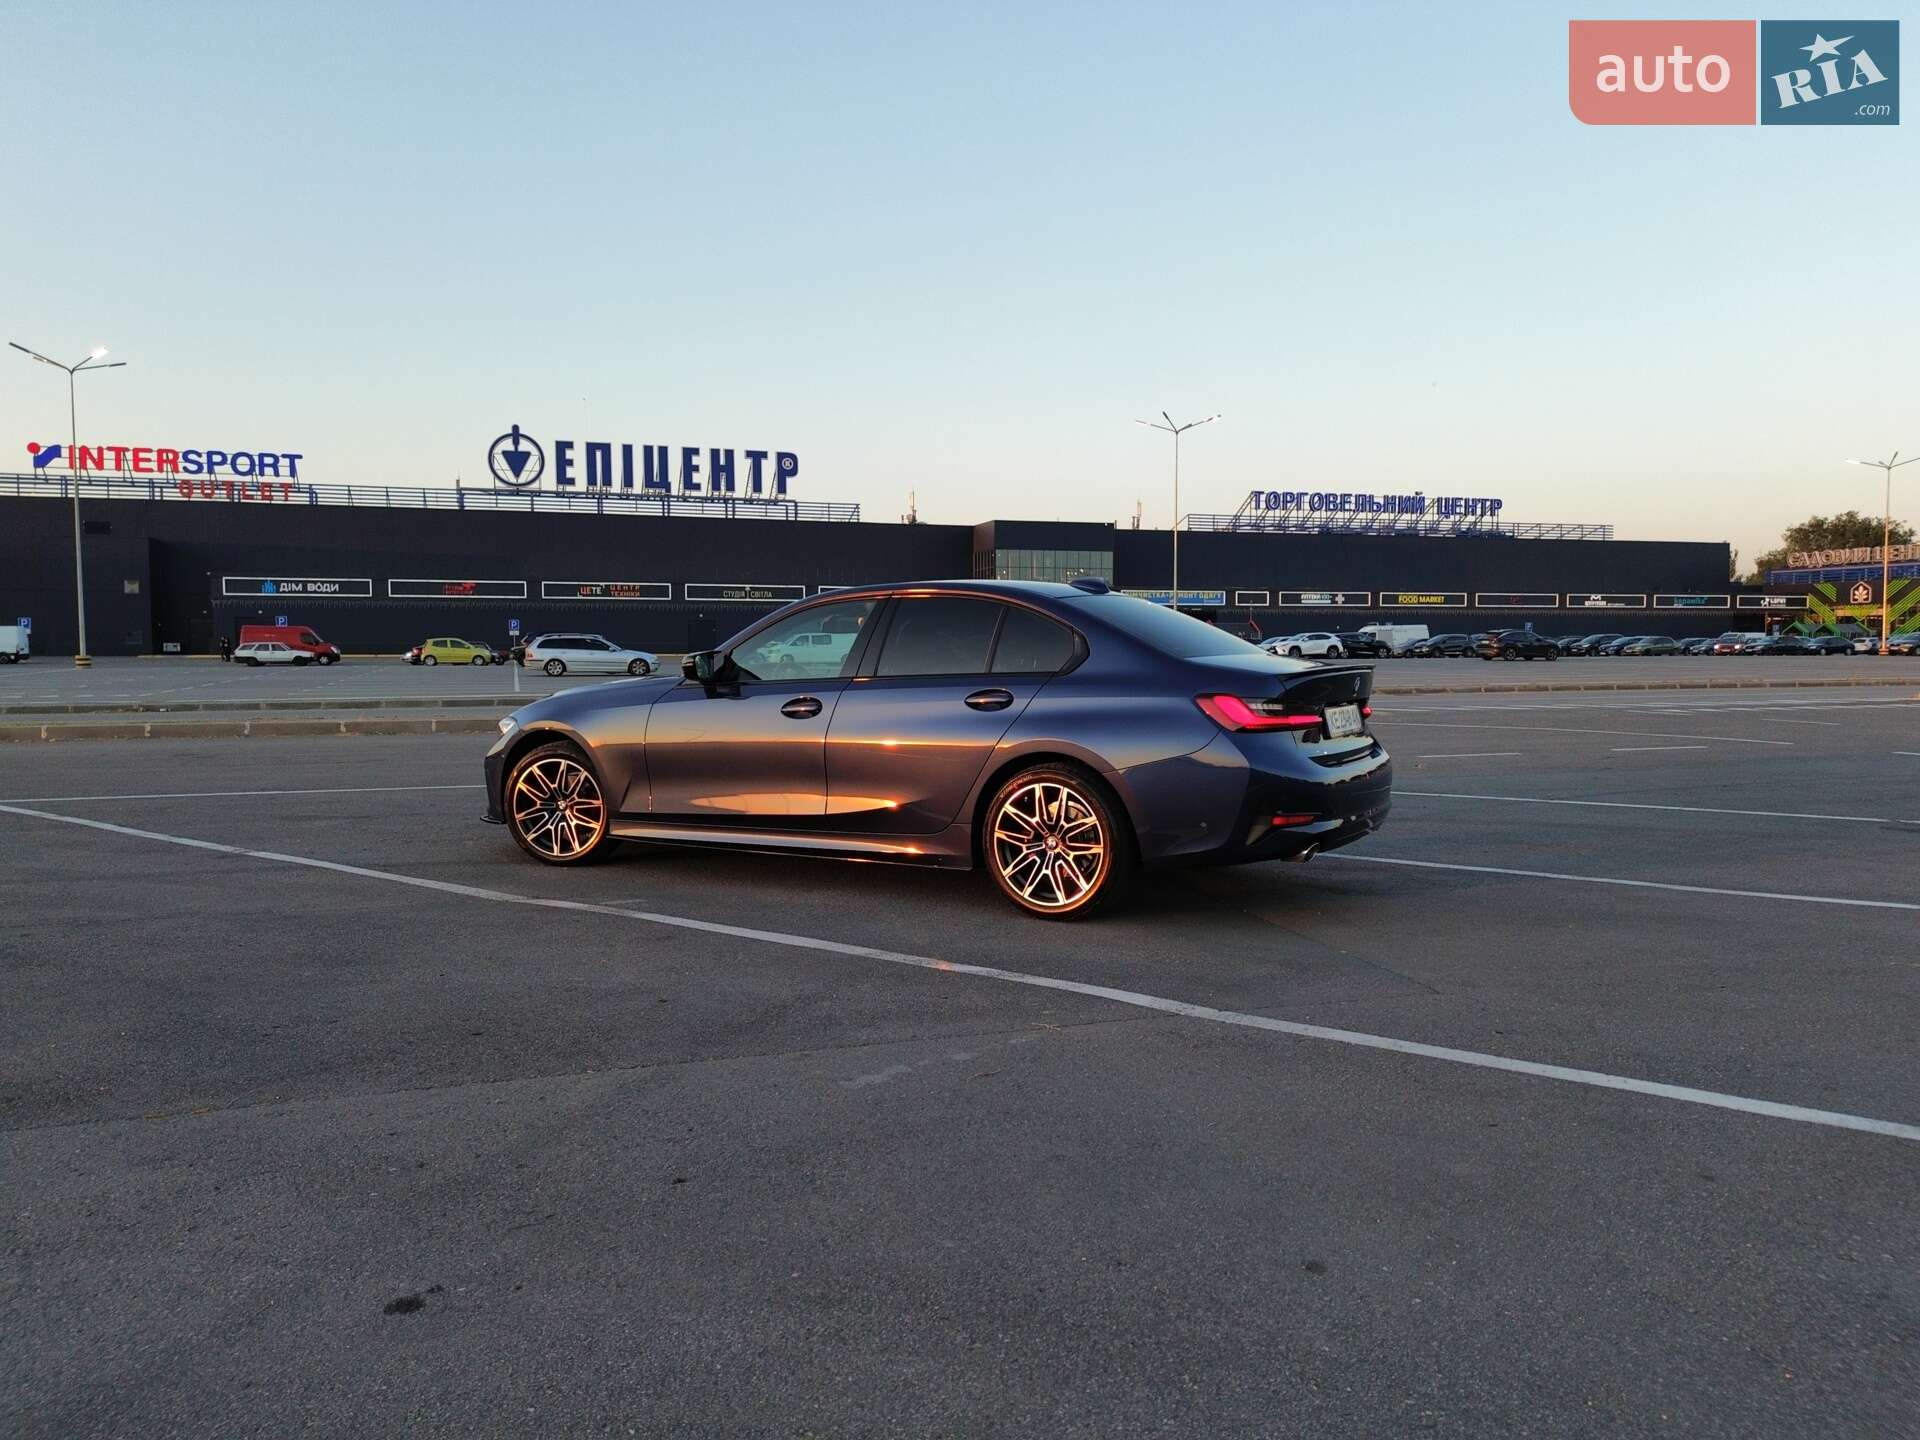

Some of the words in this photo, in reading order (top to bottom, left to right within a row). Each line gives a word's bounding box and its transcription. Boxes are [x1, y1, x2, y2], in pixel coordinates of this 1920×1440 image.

[68, 444, 303, 478] INTERSPORT
[554, 440, 799, 494] ЕПІЦЕНТР
[179, 480, 292, 501] OUTLET
[1253, 490, 1427, 514] ТОРГОВЕЛЬНИЙ
[1437, 496, 1503, 518] ЦЕНТР
[280, 582, 303, 592] ДІМ
[1398, 595, 1418, 604] FOOD
[1419, 595, 1445, 604] MARKET
